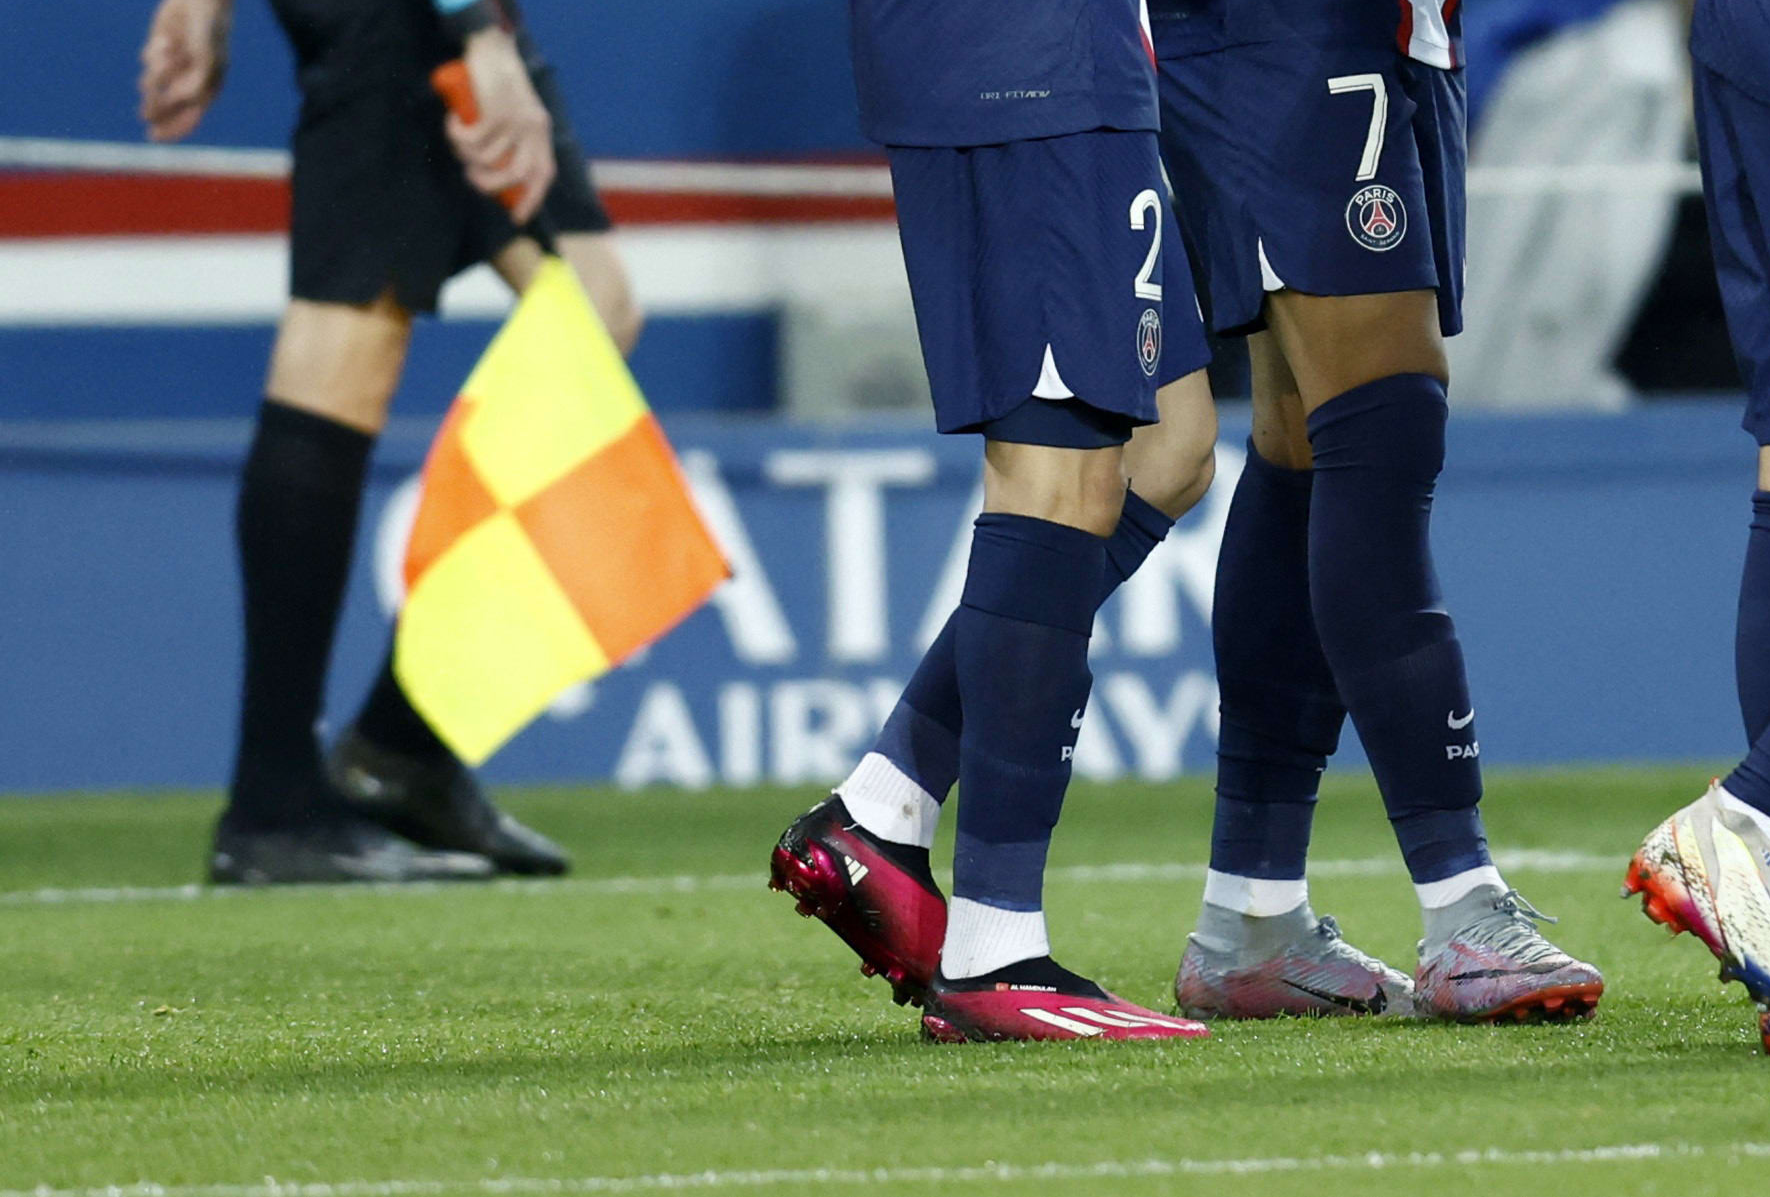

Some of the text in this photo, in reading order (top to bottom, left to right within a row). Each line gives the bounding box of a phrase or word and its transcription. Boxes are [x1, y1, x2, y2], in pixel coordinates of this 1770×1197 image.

[1327, 73, 1388, 182] 7
[1129, 189, 1163, 302] 2
[1355, 188, 1395, 206] PARIS
